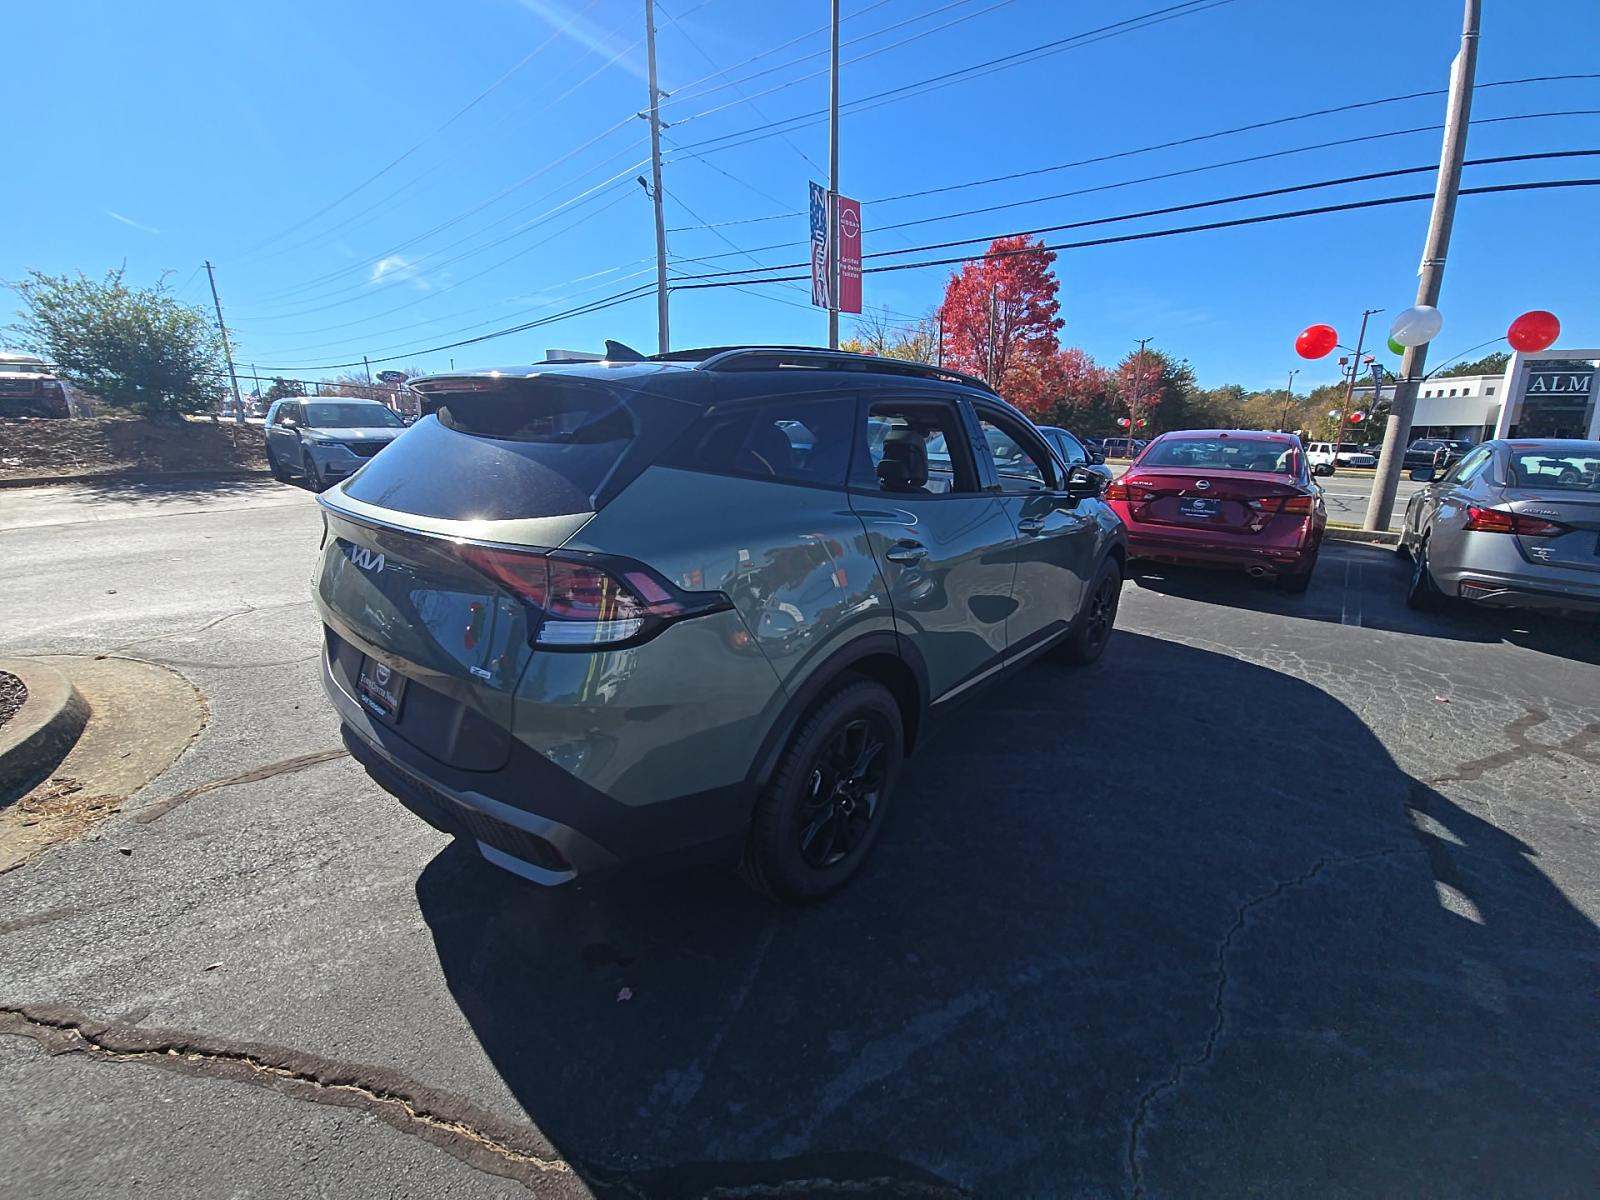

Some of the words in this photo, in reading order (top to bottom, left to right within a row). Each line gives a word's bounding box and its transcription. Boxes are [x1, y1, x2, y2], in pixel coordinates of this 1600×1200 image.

[814, 189, 826, 303] NISSAN
[1529, 375, 1591, 392] ALM
[351, 544, 385, 573] KIA
